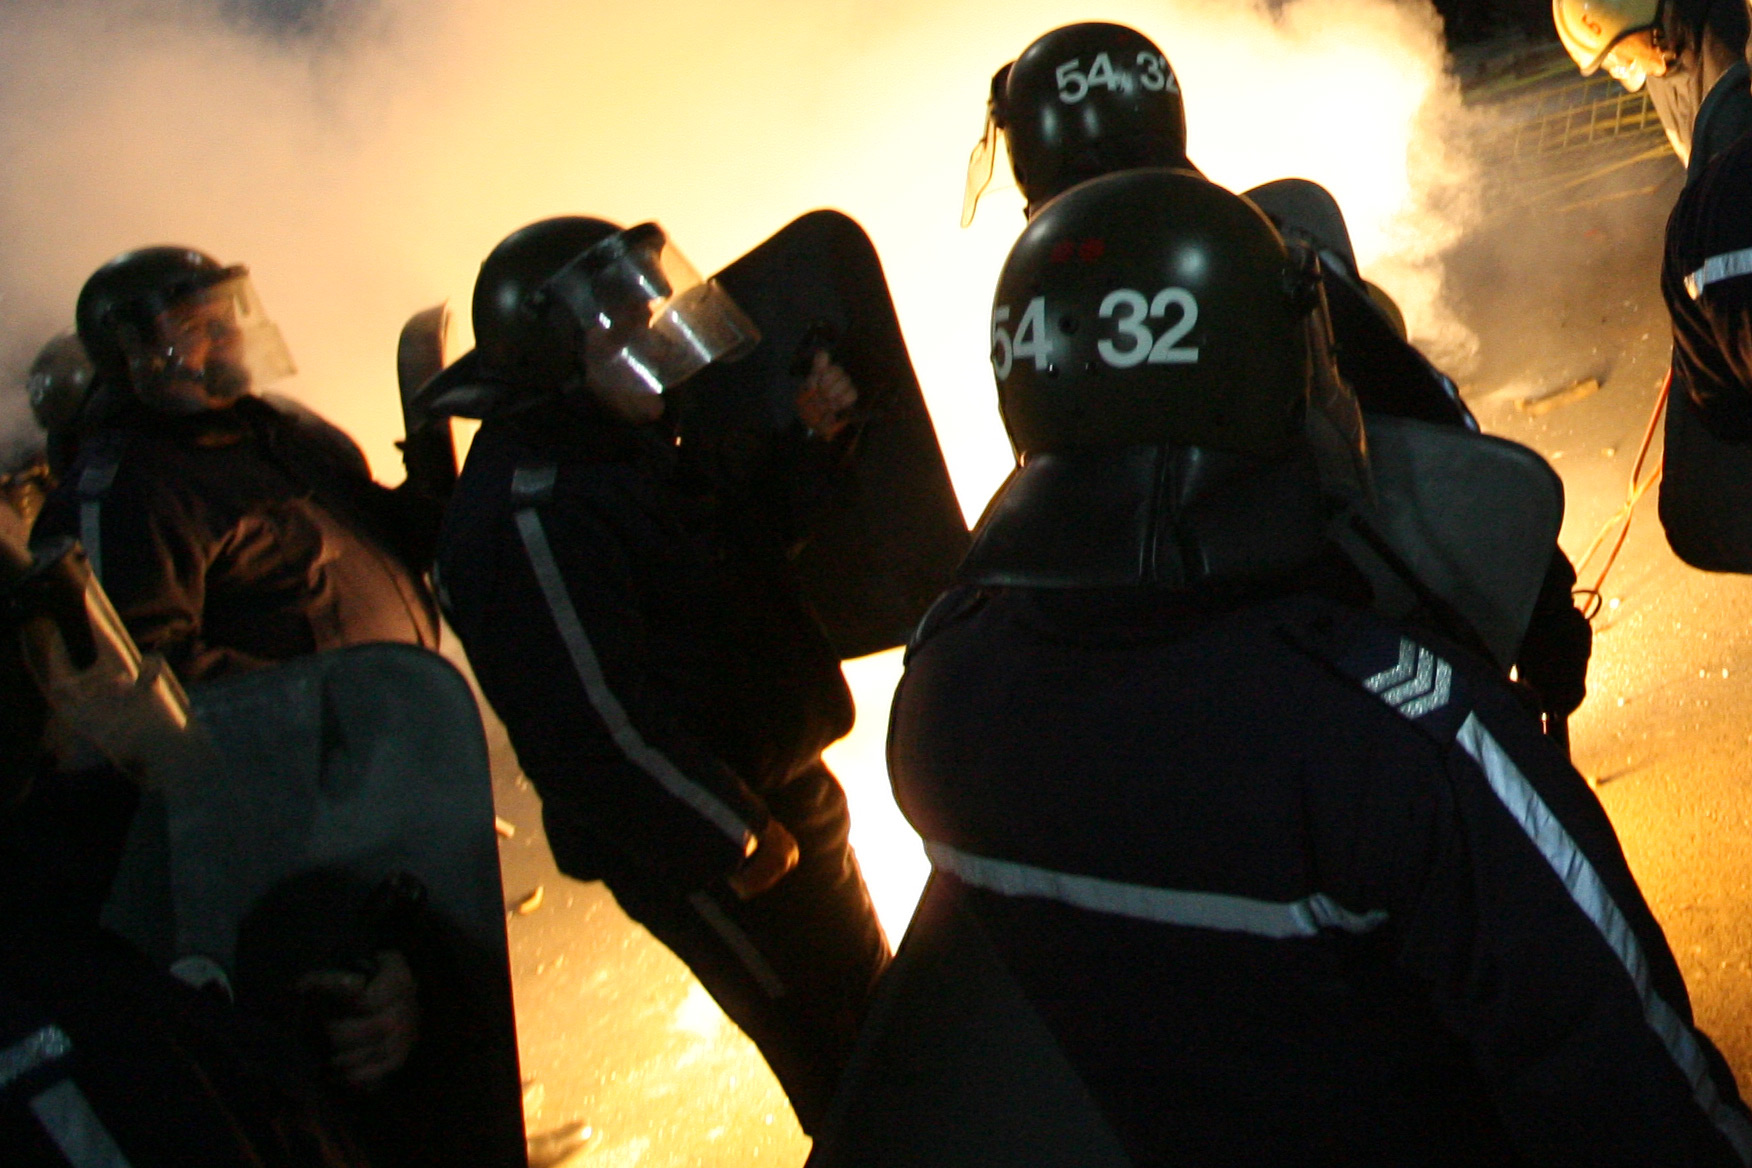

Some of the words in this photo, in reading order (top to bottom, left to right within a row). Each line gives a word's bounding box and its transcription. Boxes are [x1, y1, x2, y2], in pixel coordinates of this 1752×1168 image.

[1055, 51, 1118, 105] 54
[993, 296, 1053, 381] 54
[1097, 286, 1199, 369] 32
